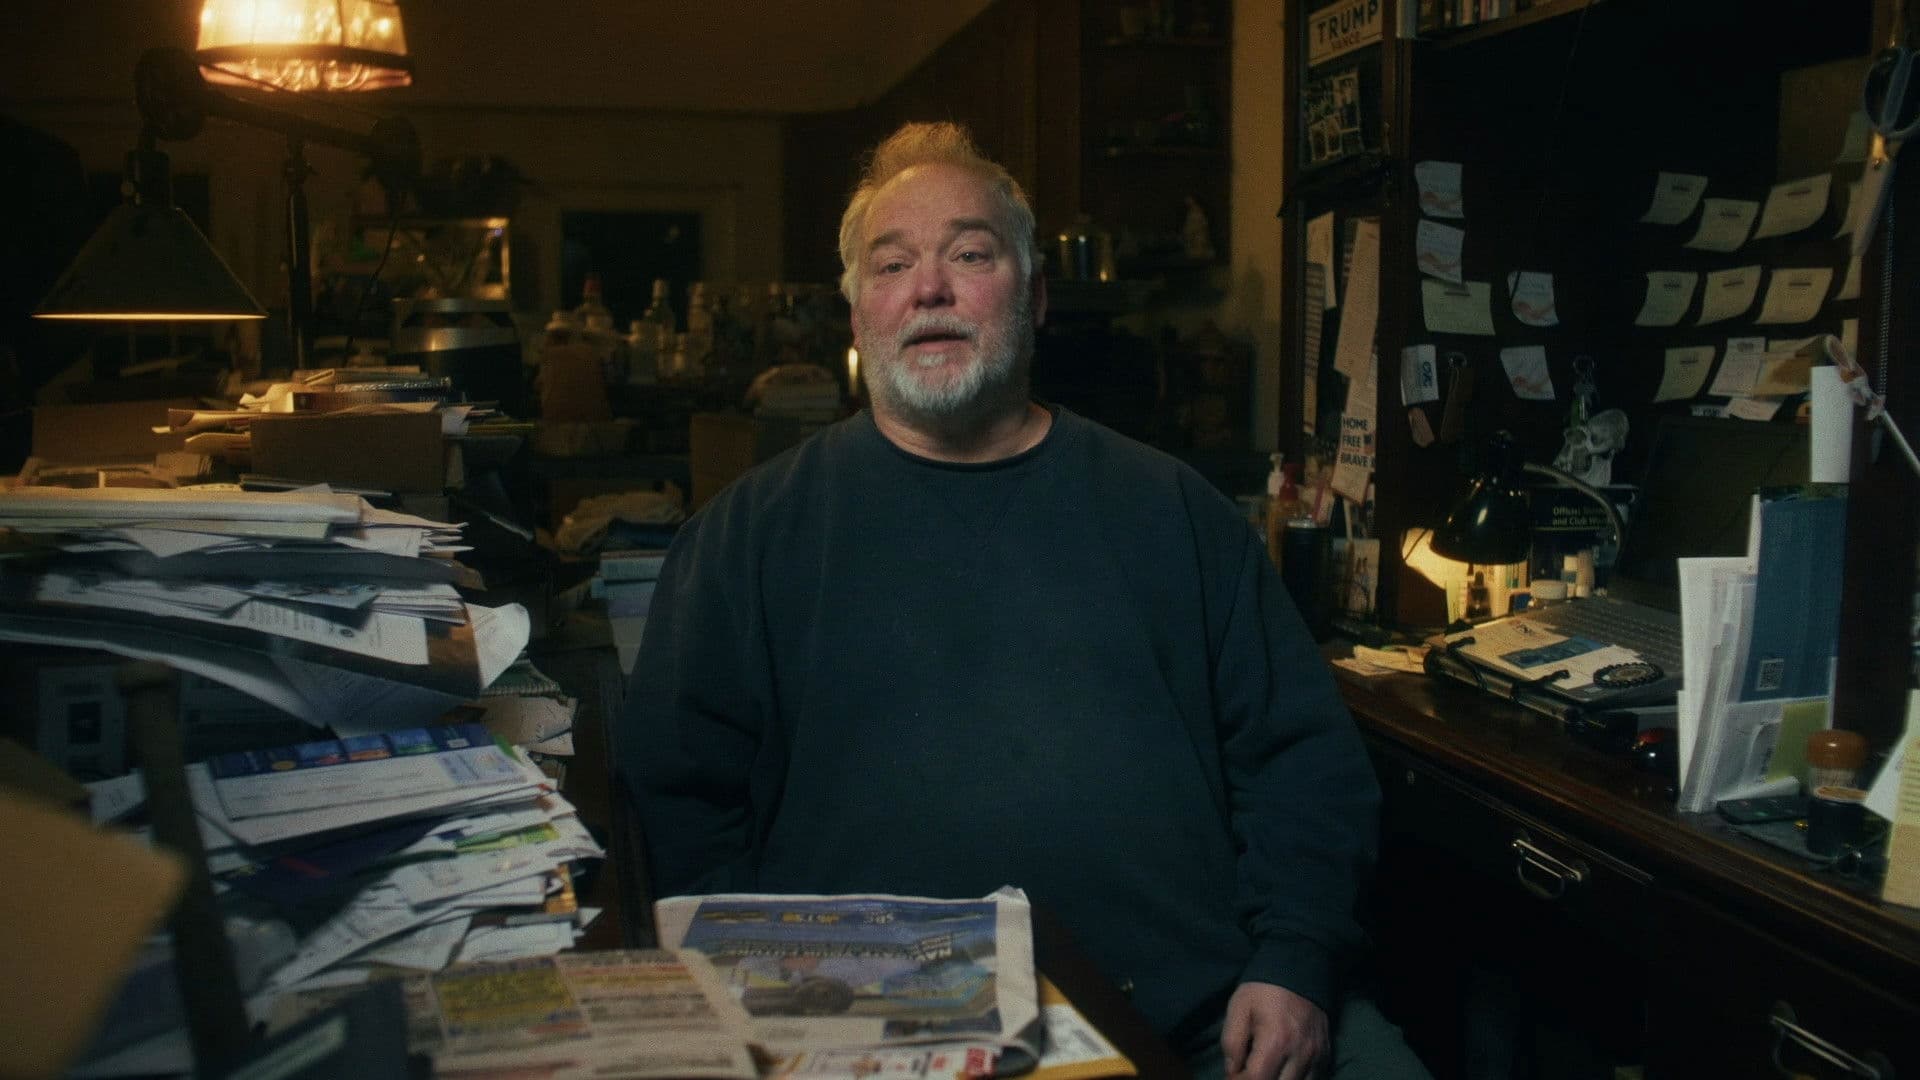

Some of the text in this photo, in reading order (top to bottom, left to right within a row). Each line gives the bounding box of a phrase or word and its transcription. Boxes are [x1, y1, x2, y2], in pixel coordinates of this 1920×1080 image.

[1318, 0, 1378, 43] TRUMP
[1343, 417, 1368, 431] HOME
[1343, 434, 1362, 448] FREE
[1341, 453, 1369, 468] BRAVE
